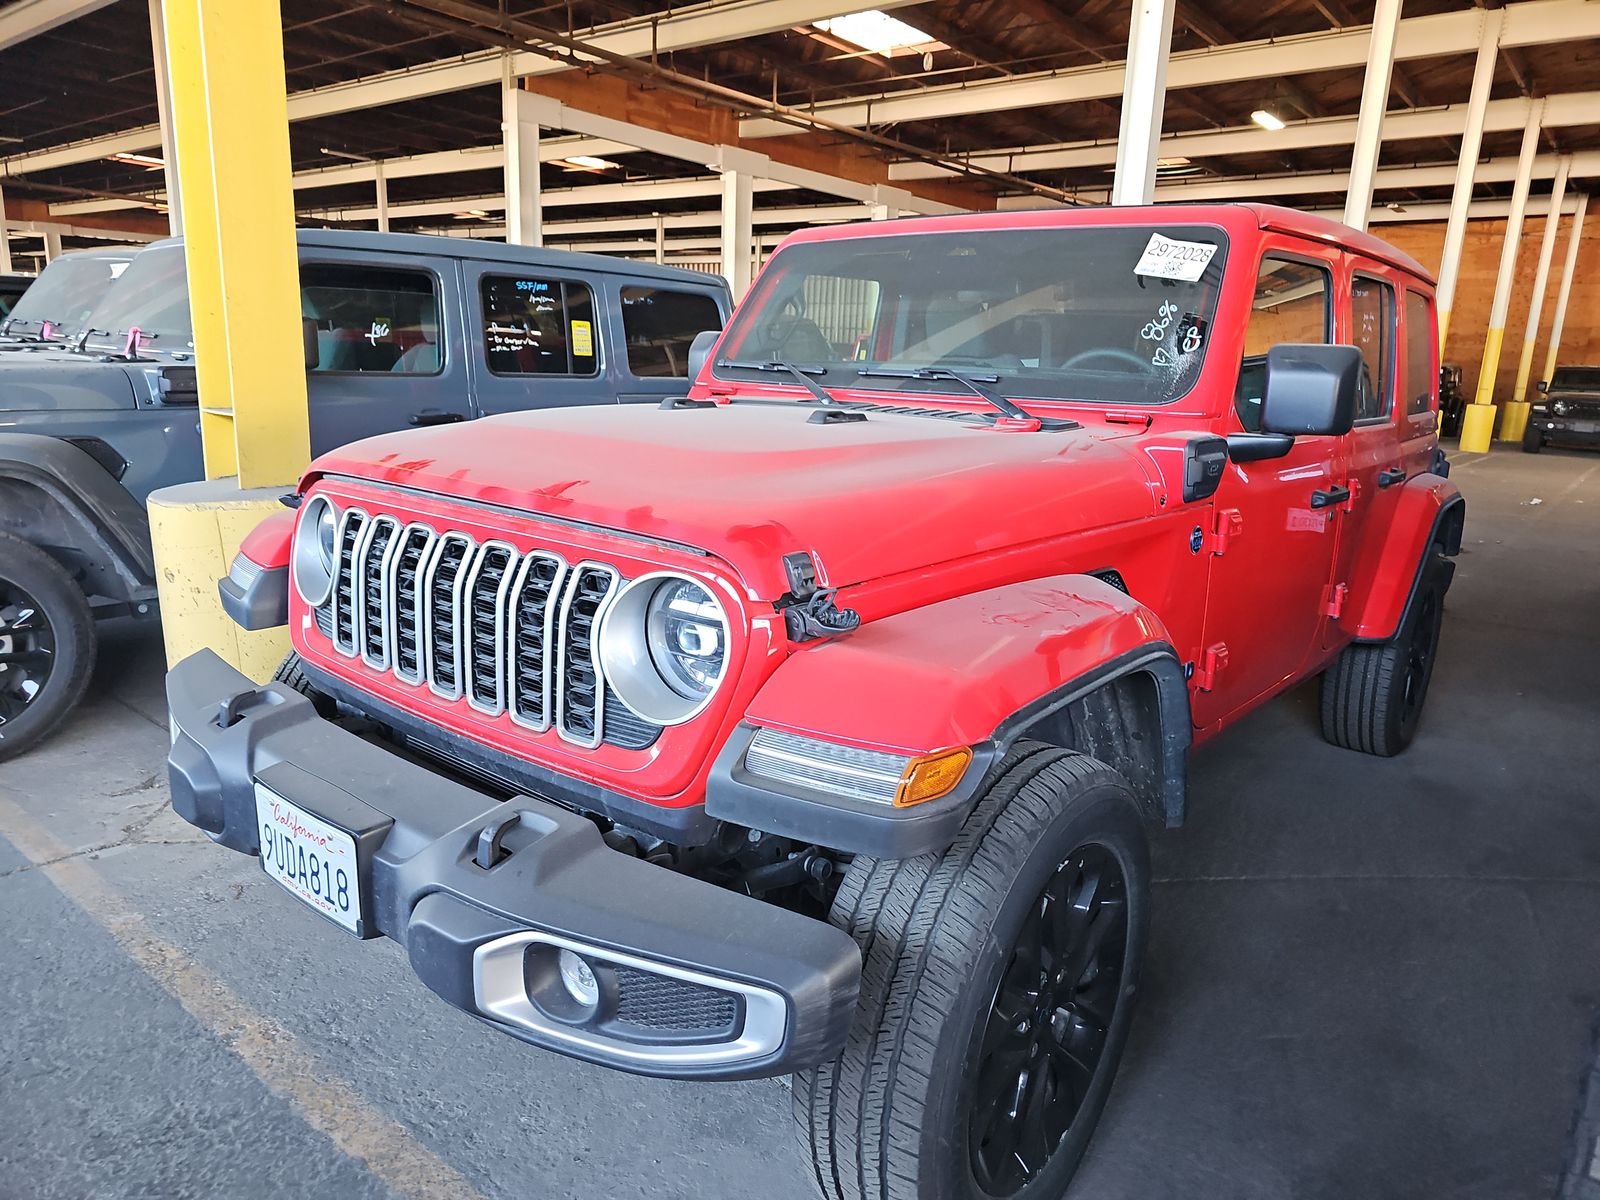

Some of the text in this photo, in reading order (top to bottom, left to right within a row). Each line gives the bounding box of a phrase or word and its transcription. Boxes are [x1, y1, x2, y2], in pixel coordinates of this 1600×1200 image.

[1148, 240, 1212, 262] 2972028
[273, 803, 334, 853] California
[264, 823, 349, 912] 9UDA818
